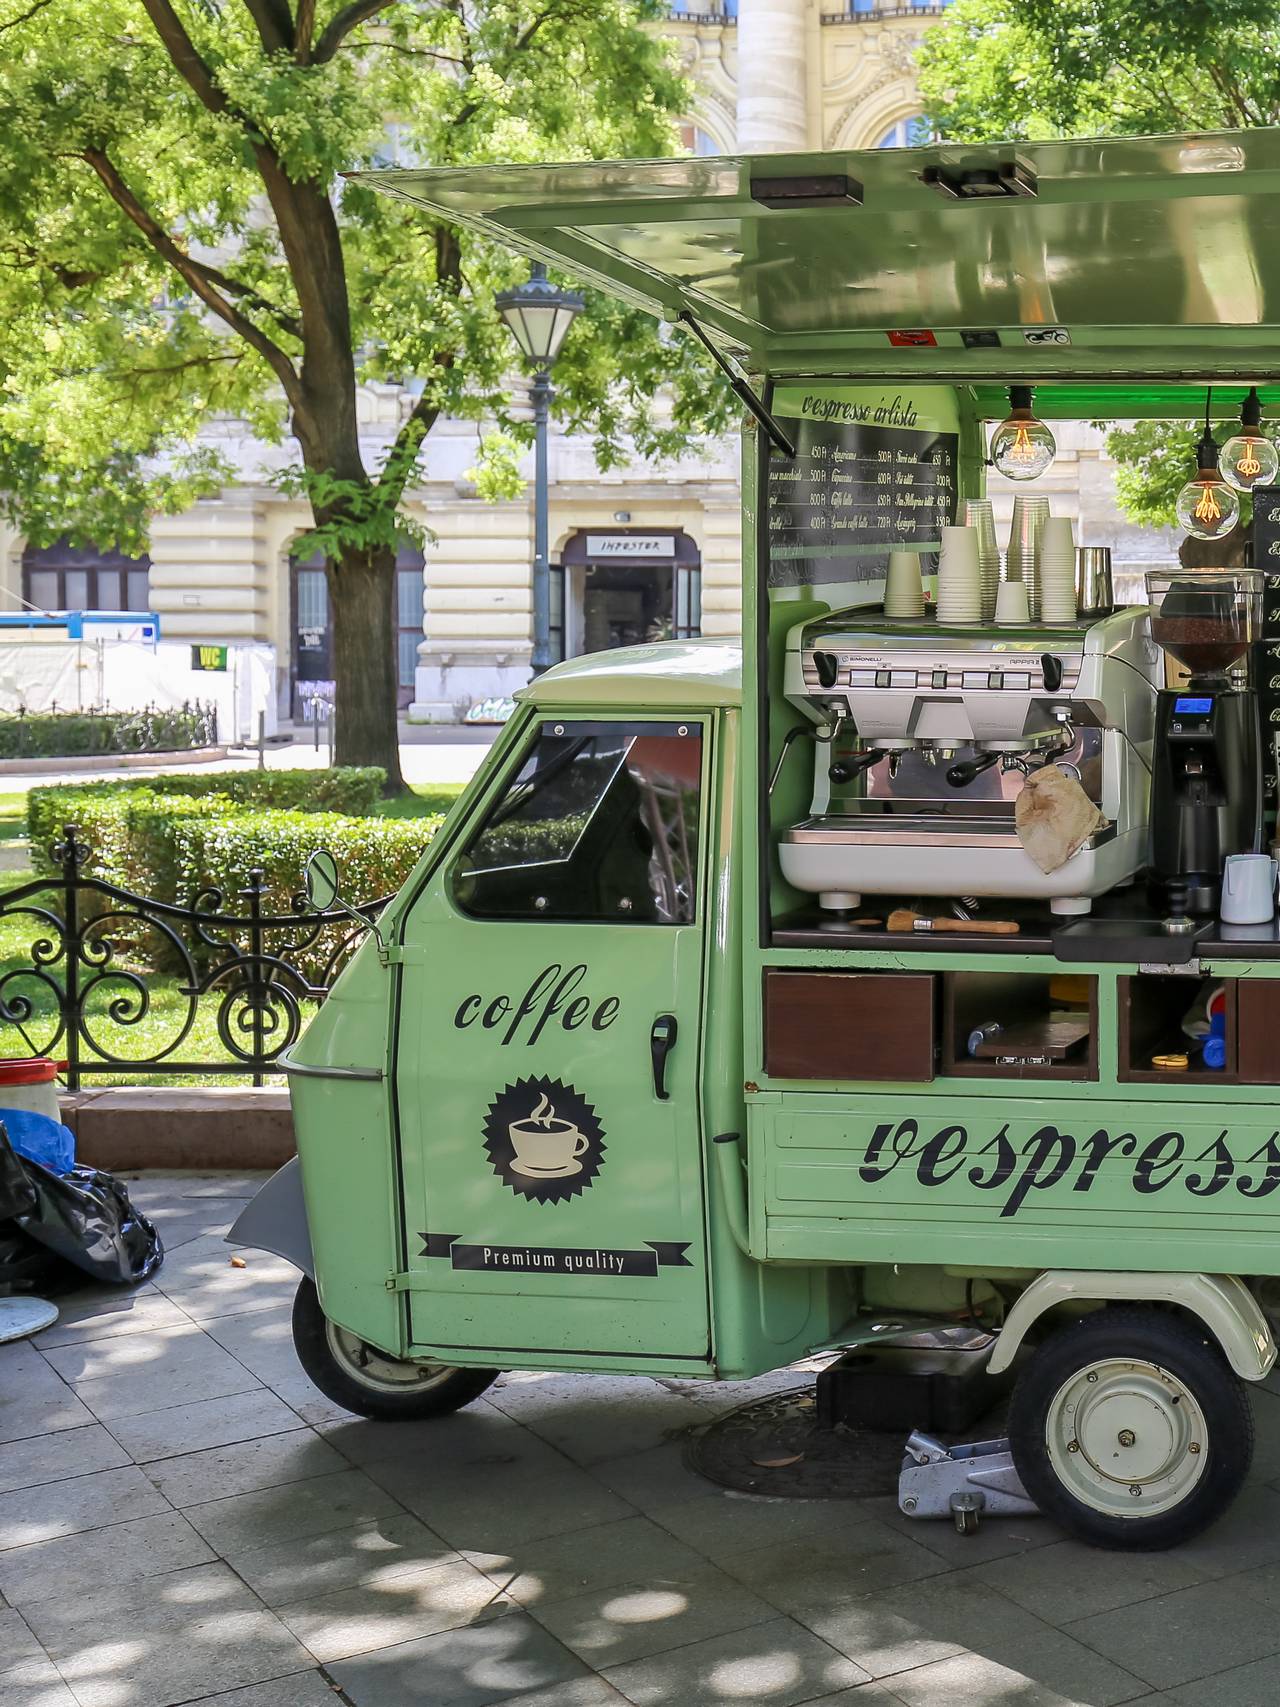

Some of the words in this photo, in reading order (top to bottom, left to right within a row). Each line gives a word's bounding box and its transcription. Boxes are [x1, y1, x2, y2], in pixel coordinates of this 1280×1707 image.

[801, 395, 871, 421] vespresso
[873, 394, 918, 427] árlista
[810, 469, 820, 482] 500
[200, 647, 221, 667] WC
[453, 963, 621, 1046] coffee
[483, 1247, 556, 1268] Premium
[564, 1251, 625, 1274] quality
